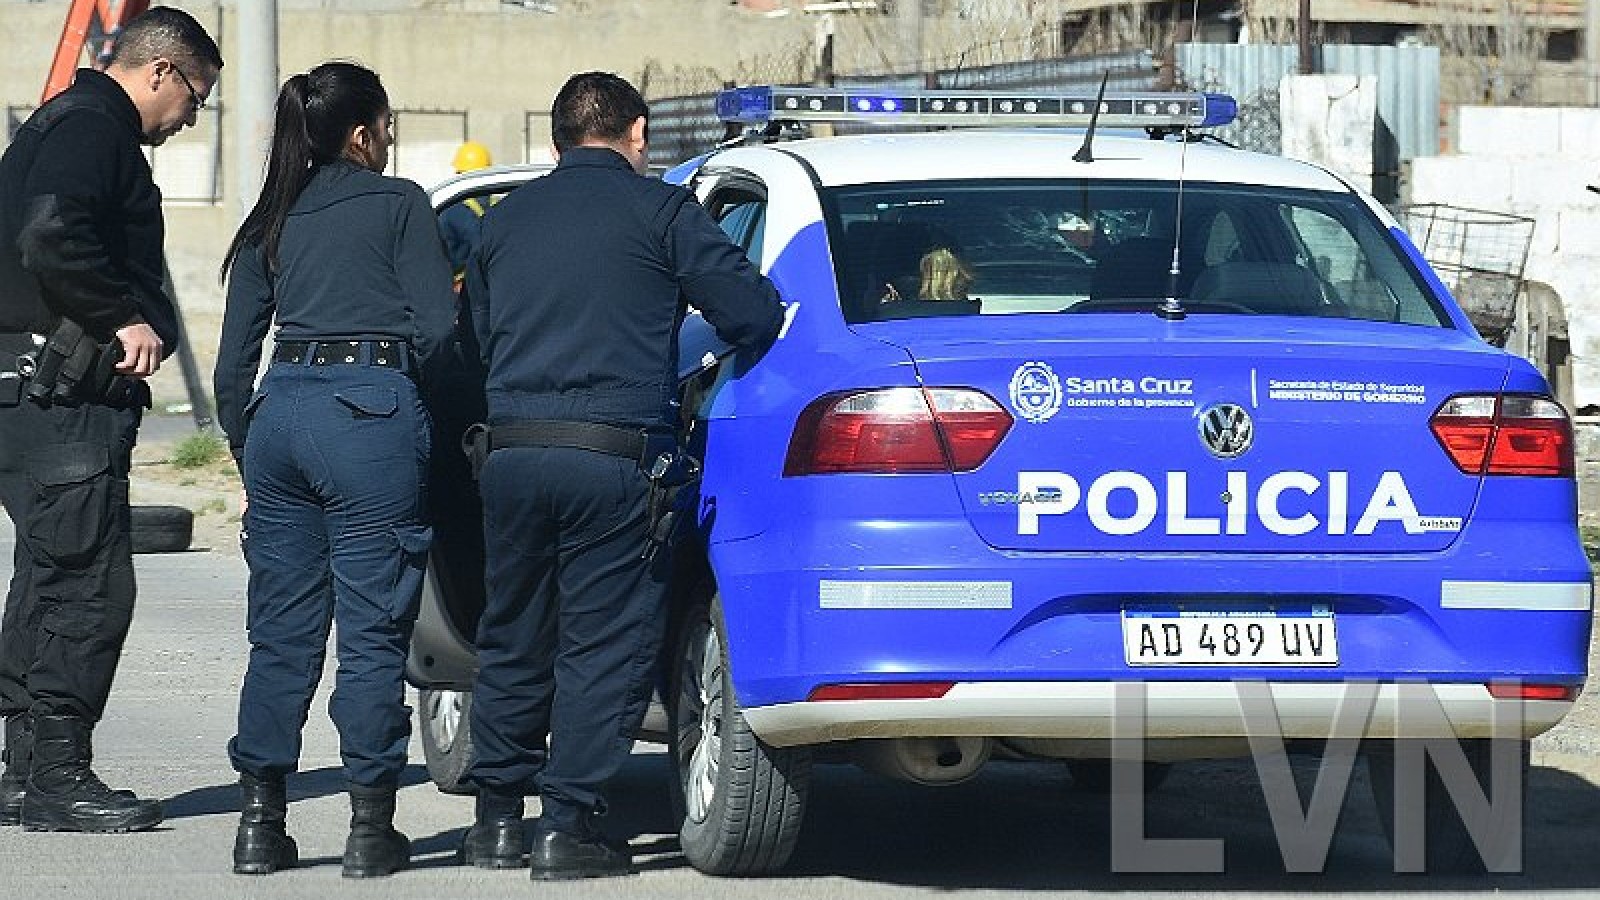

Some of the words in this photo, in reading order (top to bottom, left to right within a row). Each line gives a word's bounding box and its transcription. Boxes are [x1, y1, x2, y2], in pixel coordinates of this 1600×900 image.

[1066, 377, 1135, 394] Santa
[1140, 377, 1193, 394] Cruz
[1332, 380, 1365, 390] Estado
[1379, 383, 1425, 393] Seguridad
[1067, 398, 1117, 407] Gobierno
[1118, 398, 1132, 407] de
[1134, 398, 1145, 407] la
[1146, 398, 1195, 409] provincia
[1269, 390, 1343, 400] MINISTERIO
[1344, 391, 1361, 401] DE
[1363, 392, 1426, 404] GOBIERNO
[1018, 471, 1420, 535] POLICIA
[1139, 623, 1183, 656] AD
[1200, 623, 1264, 656] 489
[1280, 623, 1323, 656] UV
